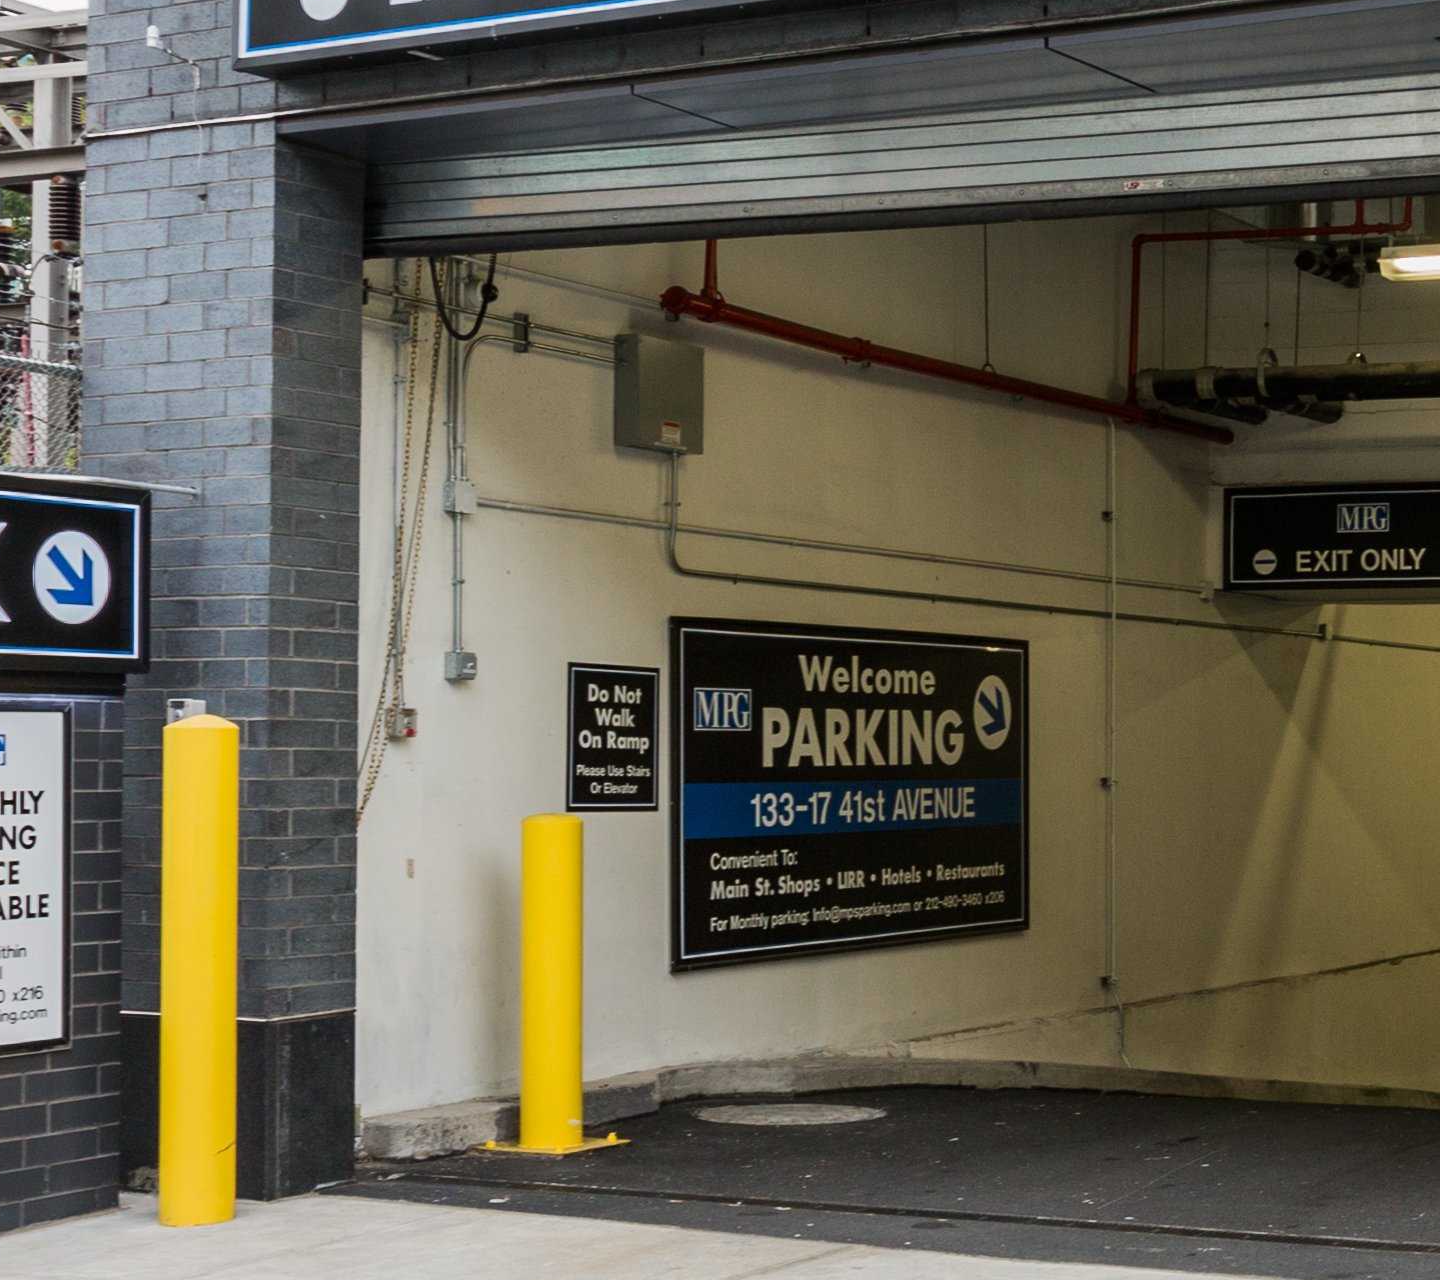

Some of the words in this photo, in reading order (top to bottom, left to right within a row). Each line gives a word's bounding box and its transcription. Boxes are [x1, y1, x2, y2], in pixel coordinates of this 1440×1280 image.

[1339, 504, 1388, 531] MPG
[1295, 550, 1353, 572] EXIT
[1361, 548, 1427, 571] ONLY
[799, 654, 936, 695] Welcome
[588, 684, 609, 703] Do
[614, 685, 642, 704] Not
[595, 707, 635, 727] Walk
[695, 689, 751, 730] MPG
[762, 707, 964, 768] PARKING
[579, 730, 602, 749] On
[606, 731, 650, 754] Ramp
[576, 764, 606, 776] Please
[607, 765, 624, 776] Use
[626, 764, 651, 777] Stairs
[590, 782, 602, 794] Or
[603, 782, 638, 794] Elevator
[750, 791, 832, 827] 133-17
[838, 792, 885, 823] 41st
[892, 786, 975, 820] AVENUE
[710, 850, 778, 870] Convenient
[780, 849, 798, 866] To:
[710, 880, 749, 900] Main
[755, 877, 774, 896] St.
[778, 875, 820, 897] Shops
[837, 870, 865, 889] LIRR
[881, 865, 922, 886] Hotels
[936, 862, 1005, 881] Restaurants
[710, 917, 727, 932] For
[730, 913, 769, 930] Monthly
